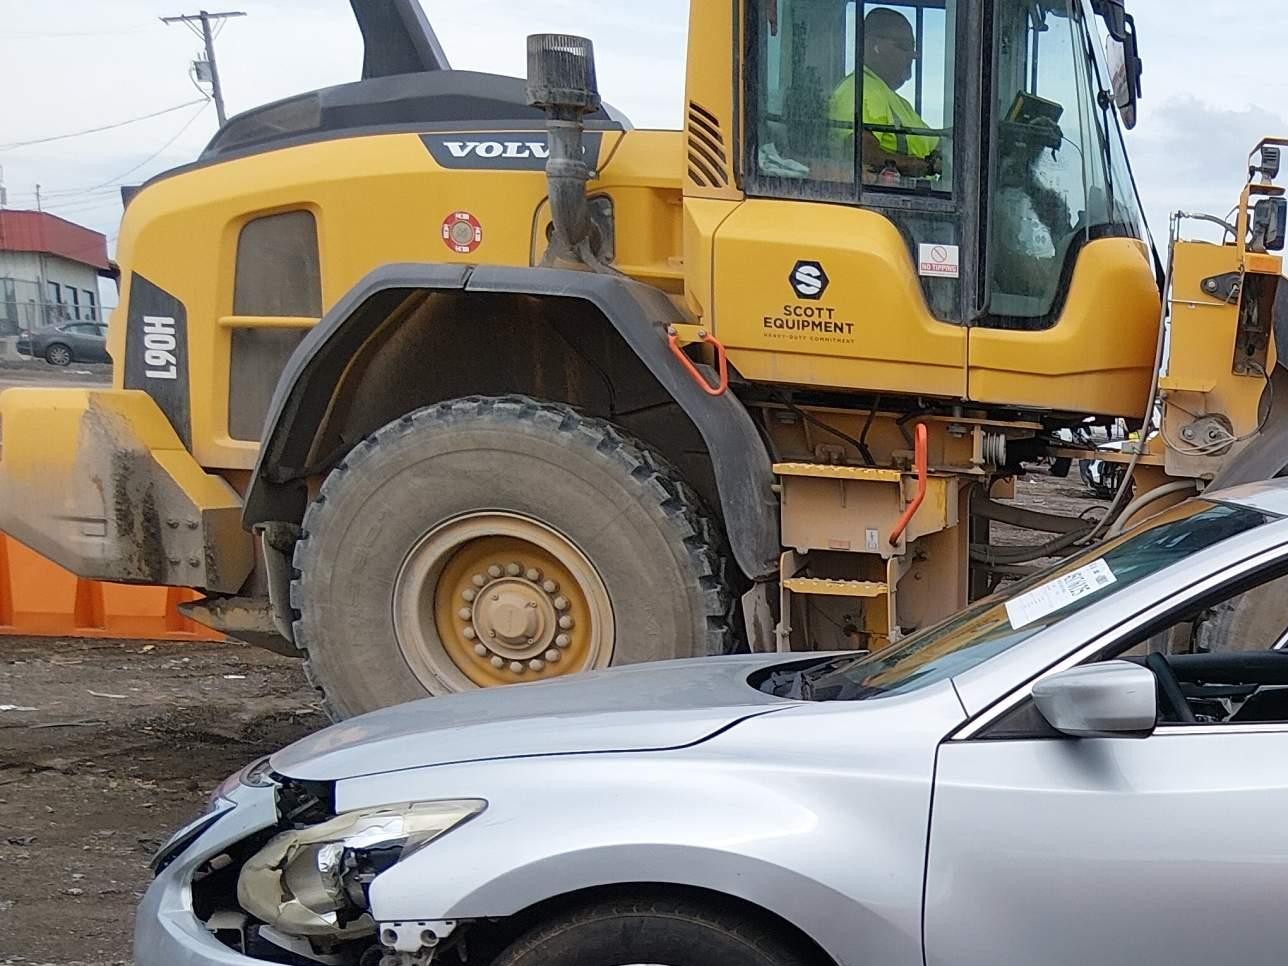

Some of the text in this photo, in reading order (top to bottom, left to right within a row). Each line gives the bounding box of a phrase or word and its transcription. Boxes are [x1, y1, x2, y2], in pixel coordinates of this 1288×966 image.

[443, 141, 585, 158] VOLV
[921, 263, 957, 272] NO TIPPING
[783, 304, 835, 320] SCOTT
[763, 316, 854, 334] EQUIPMENT
[143, 315, 177, 379] L90H
